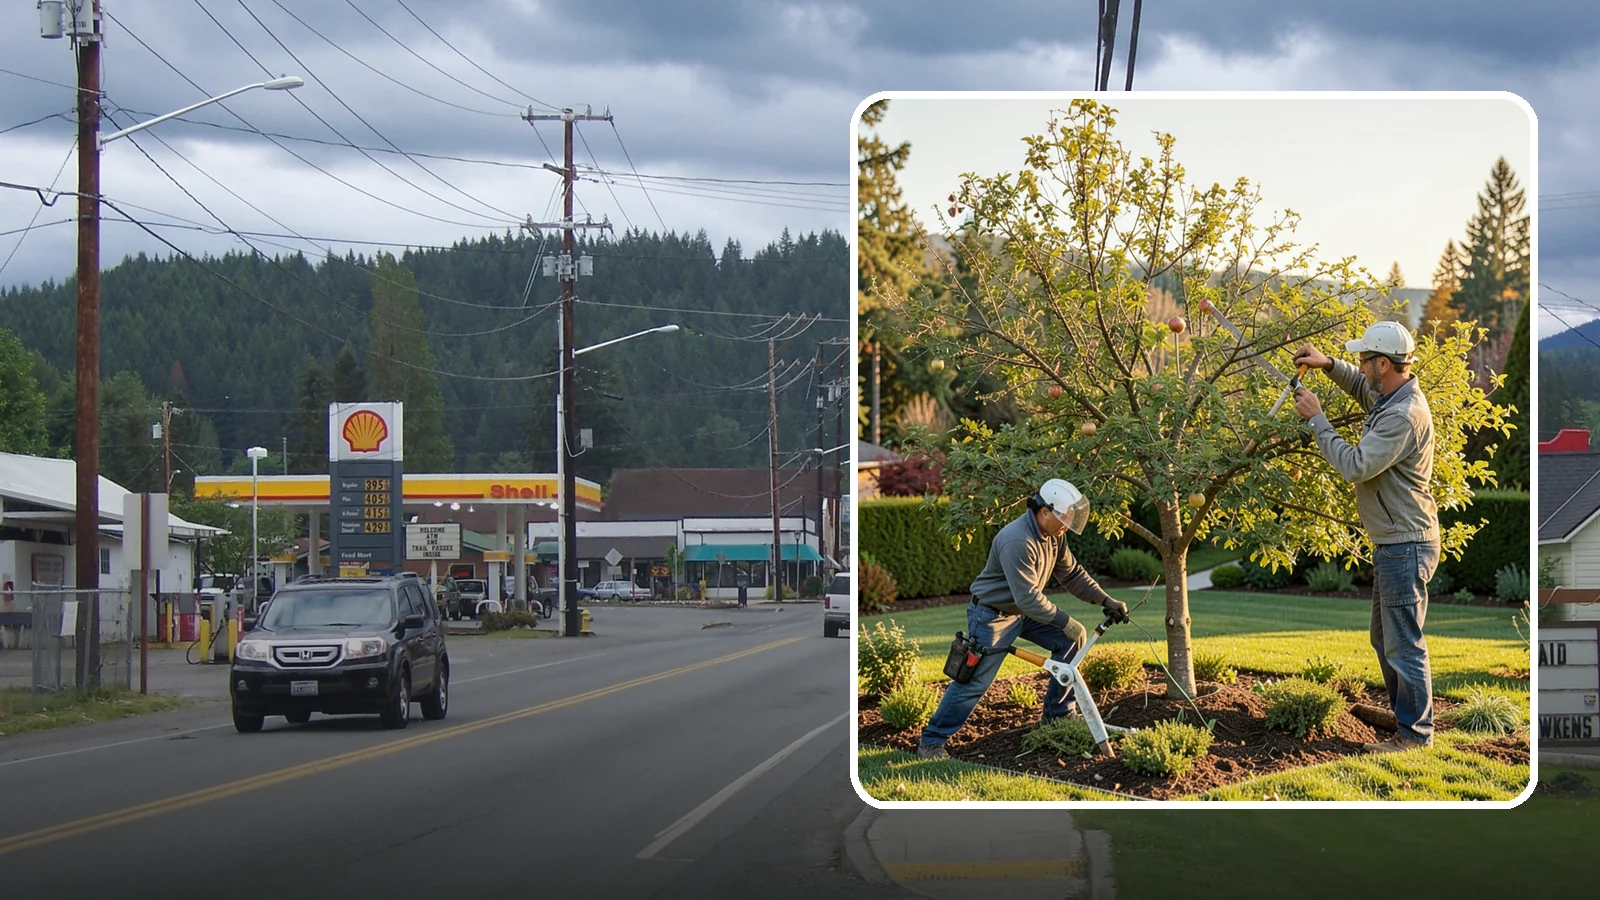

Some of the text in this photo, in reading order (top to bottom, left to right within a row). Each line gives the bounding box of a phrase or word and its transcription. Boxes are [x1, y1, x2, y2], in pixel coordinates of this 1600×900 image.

[366, 480, 383, 490] 395
[489, 484, 547, 499] Shell
[366, 494, 383, 504] 405
[366, 508, 383, 518] 415
[366, 522, 383, 532] 429
[1539, 642, 1566, 665] AID
